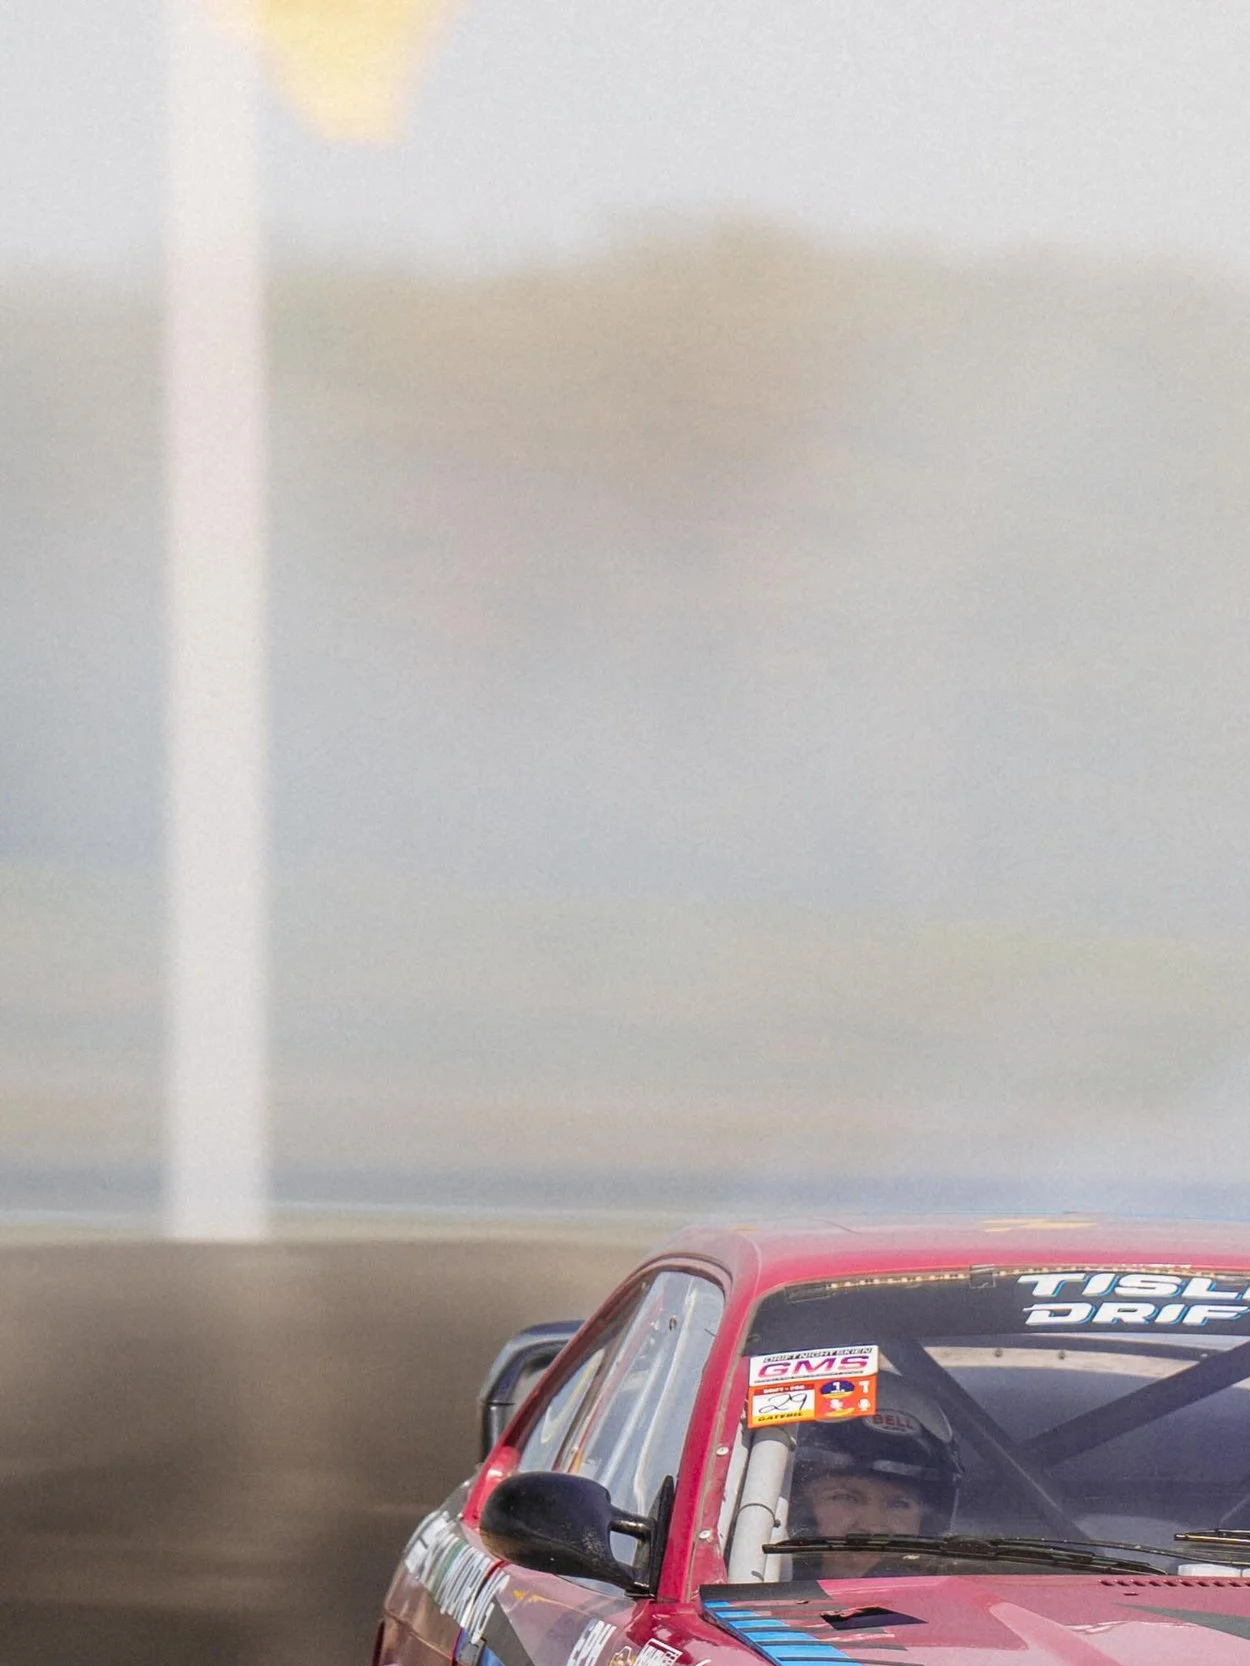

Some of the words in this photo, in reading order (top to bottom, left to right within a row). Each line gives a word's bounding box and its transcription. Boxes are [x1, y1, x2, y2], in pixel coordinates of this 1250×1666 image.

[758, 1355, 869, 1378] GMS
[758, 1392, 808, 1414] 29
[872, 1414, 916, 1430] BELL
